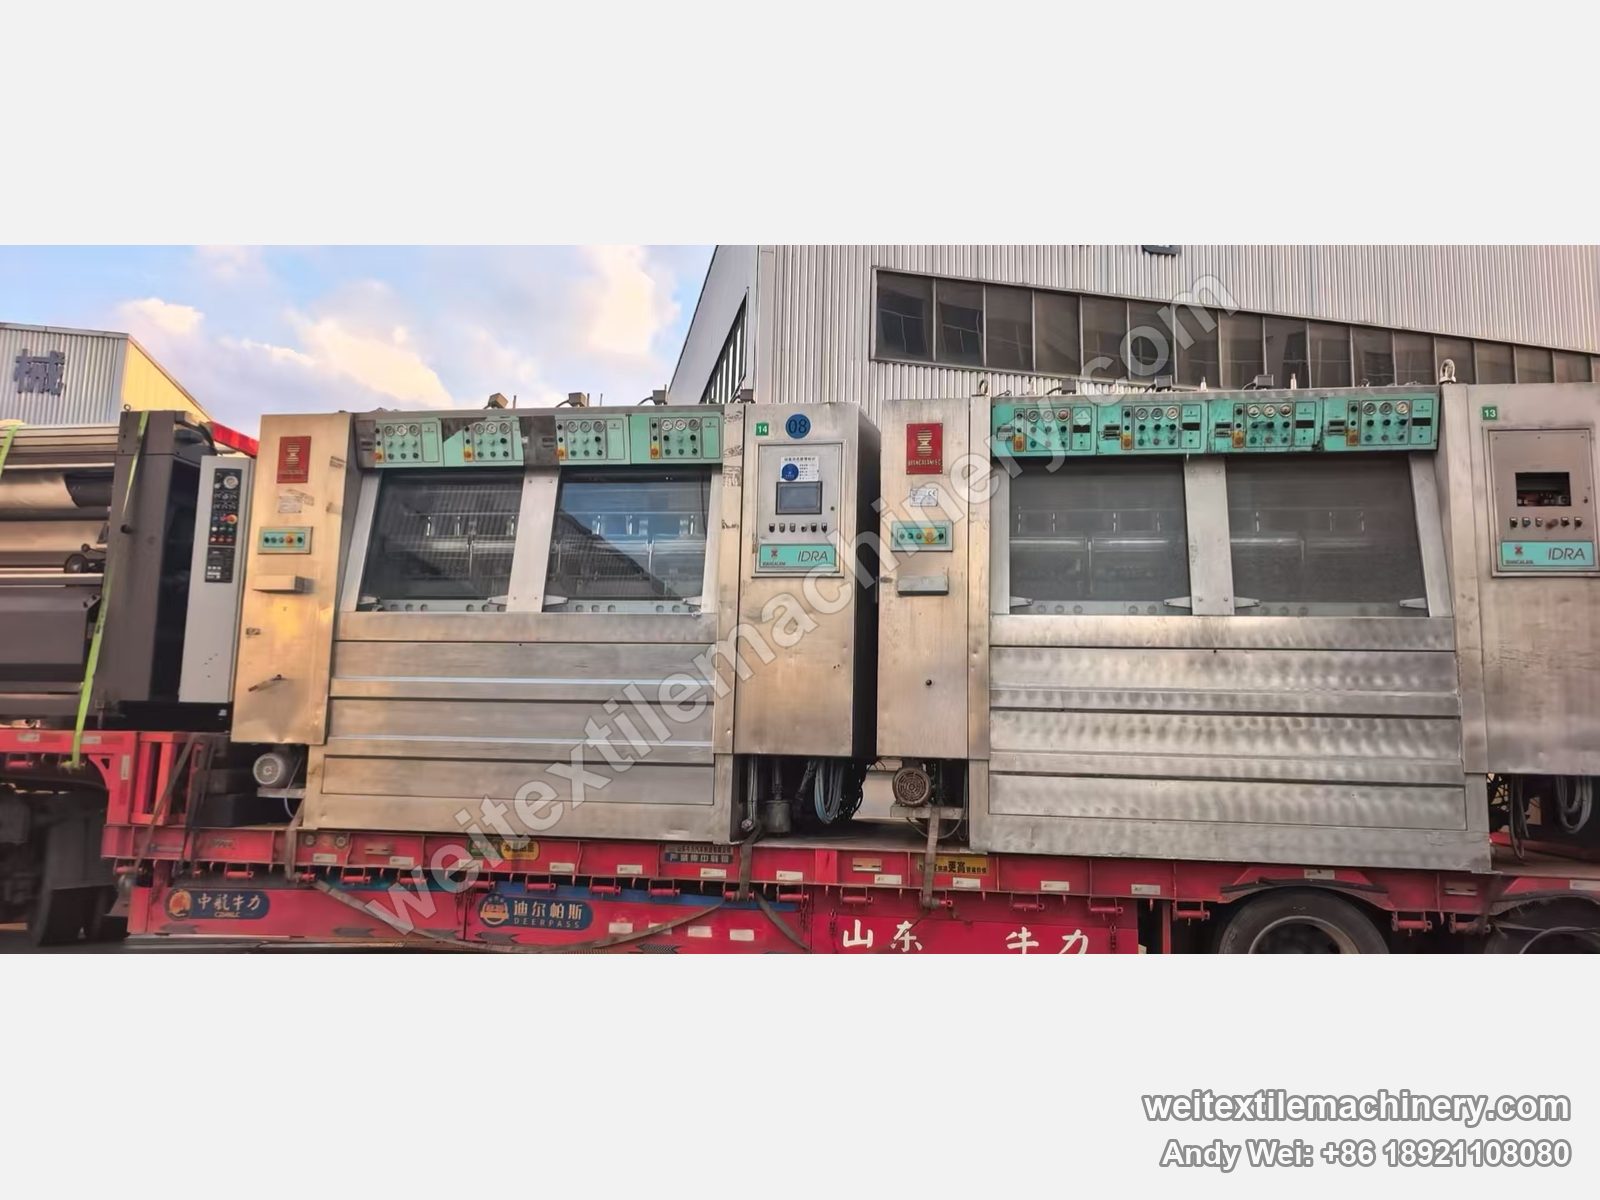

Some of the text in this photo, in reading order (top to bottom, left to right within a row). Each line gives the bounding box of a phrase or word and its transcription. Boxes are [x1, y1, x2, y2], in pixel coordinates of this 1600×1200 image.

[1484, 409, 1496, 418] 13
[757, 424, 768, 434] 14
[788, 418, 807, 434] 08
[797, 550, 828, 562] IDRA
[1547, 547, 1585, 561] IDRA
[513, 900, 583, 920] 迪尔帕斯
[514, 917, 580, 929] DEERPASS
[842, 919, 1089, 954] 山东 牛力
